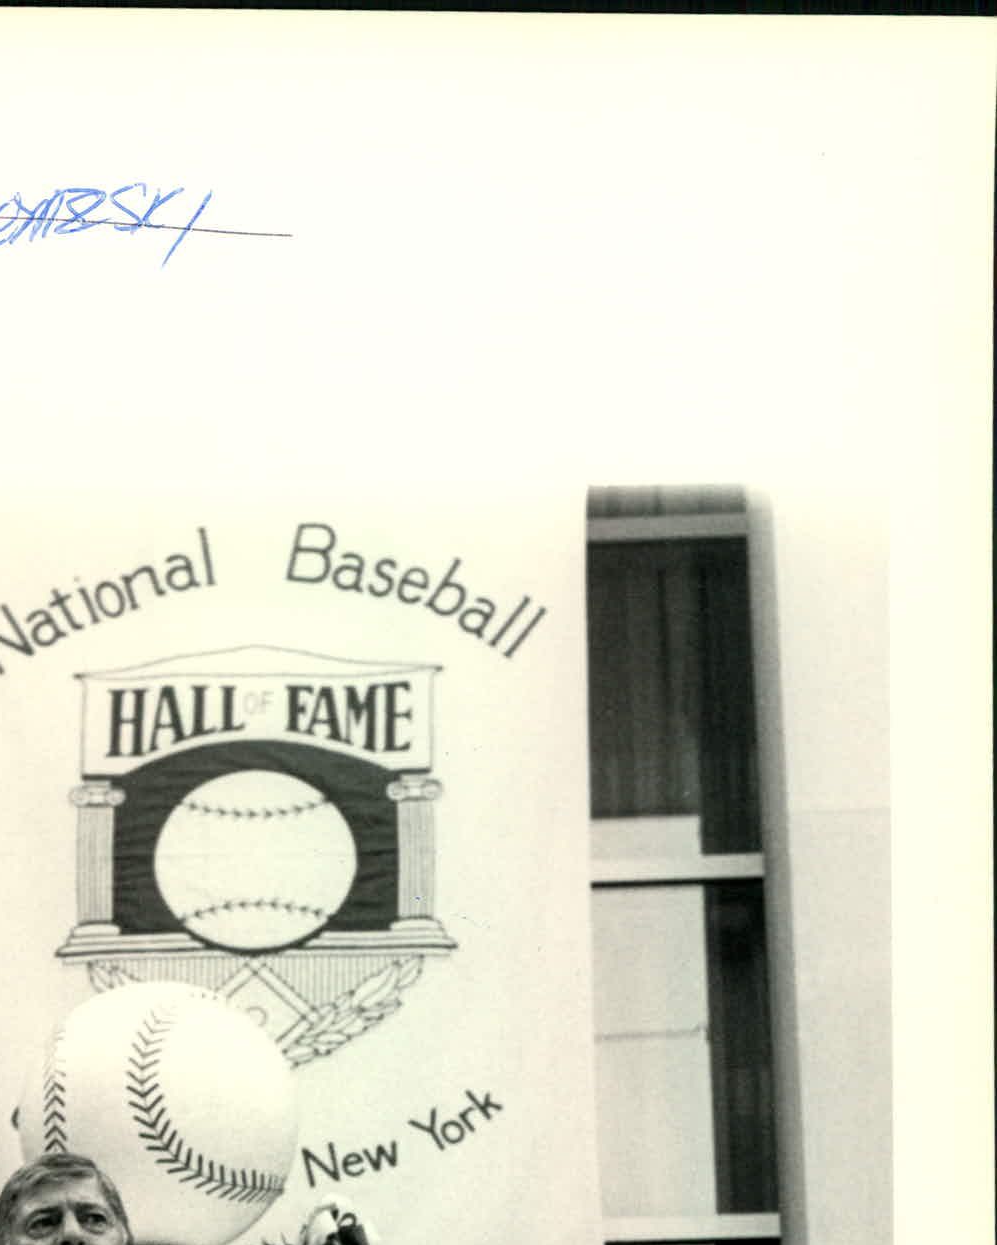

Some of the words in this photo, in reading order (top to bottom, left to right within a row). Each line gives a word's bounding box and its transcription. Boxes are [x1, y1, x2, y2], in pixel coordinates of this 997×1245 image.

[286, 522, 546, 660] Baseball
[107, 685, 247, 758] HALL
[244, 689, 273, 714] OF
[285, 681, 415, 753] FAME
[302, 1141, 399, 1189] New
[408, 1089, 502, 1156] York
